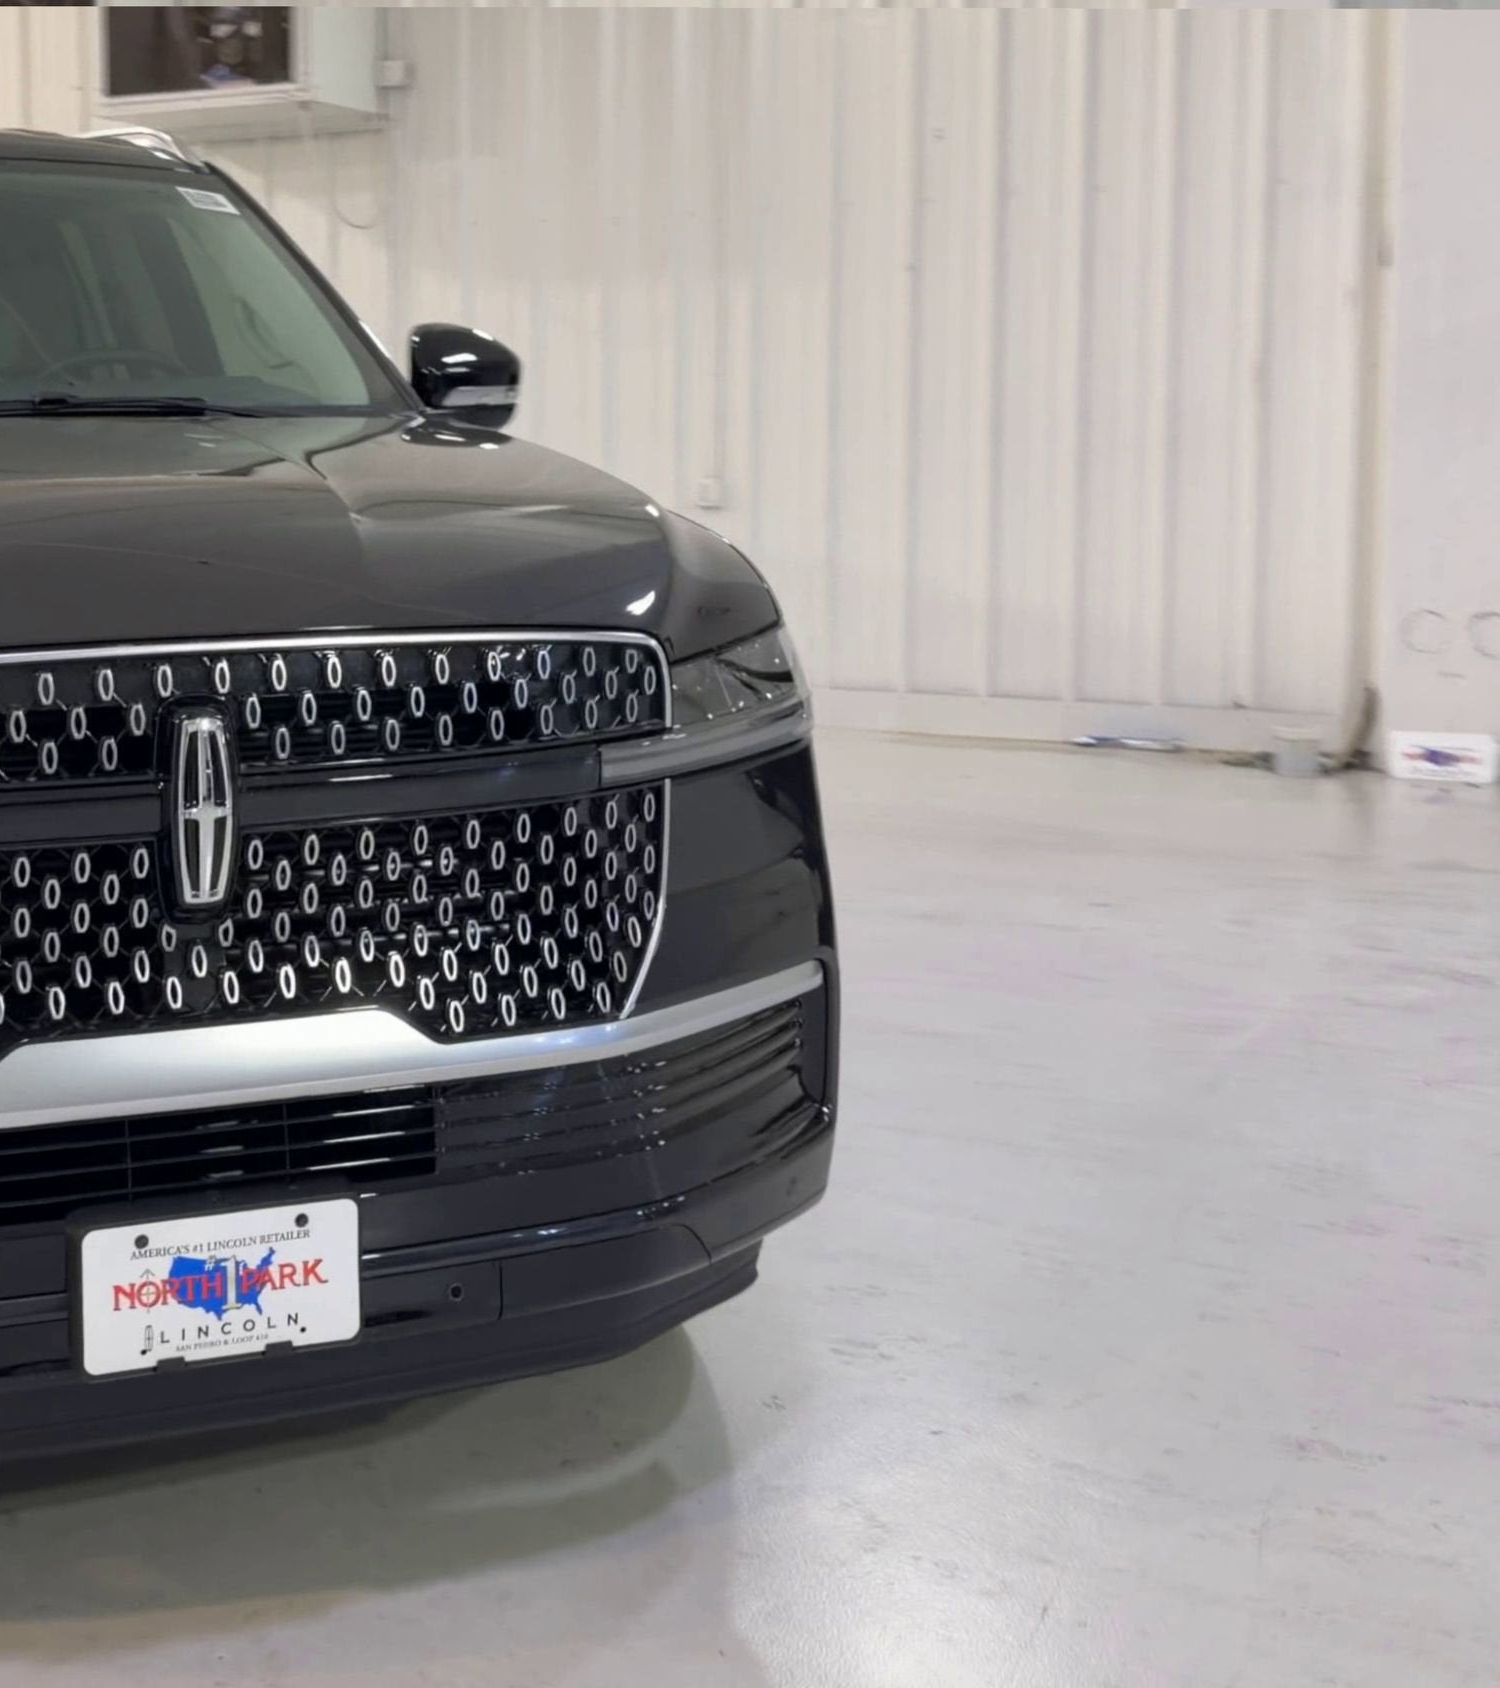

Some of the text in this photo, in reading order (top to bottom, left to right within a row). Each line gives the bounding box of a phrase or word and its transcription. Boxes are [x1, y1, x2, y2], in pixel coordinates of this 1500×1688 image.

[130, 1244, 190, 1261] AMERICA'S
[207, 1235, 257, 1252] LINCOLN
[259, 1229, 310, 1245] RETAILER
[112, 1258, 329, 1311] NORTH PARK
[159, 1312, 299, 1344] LINCOLN
